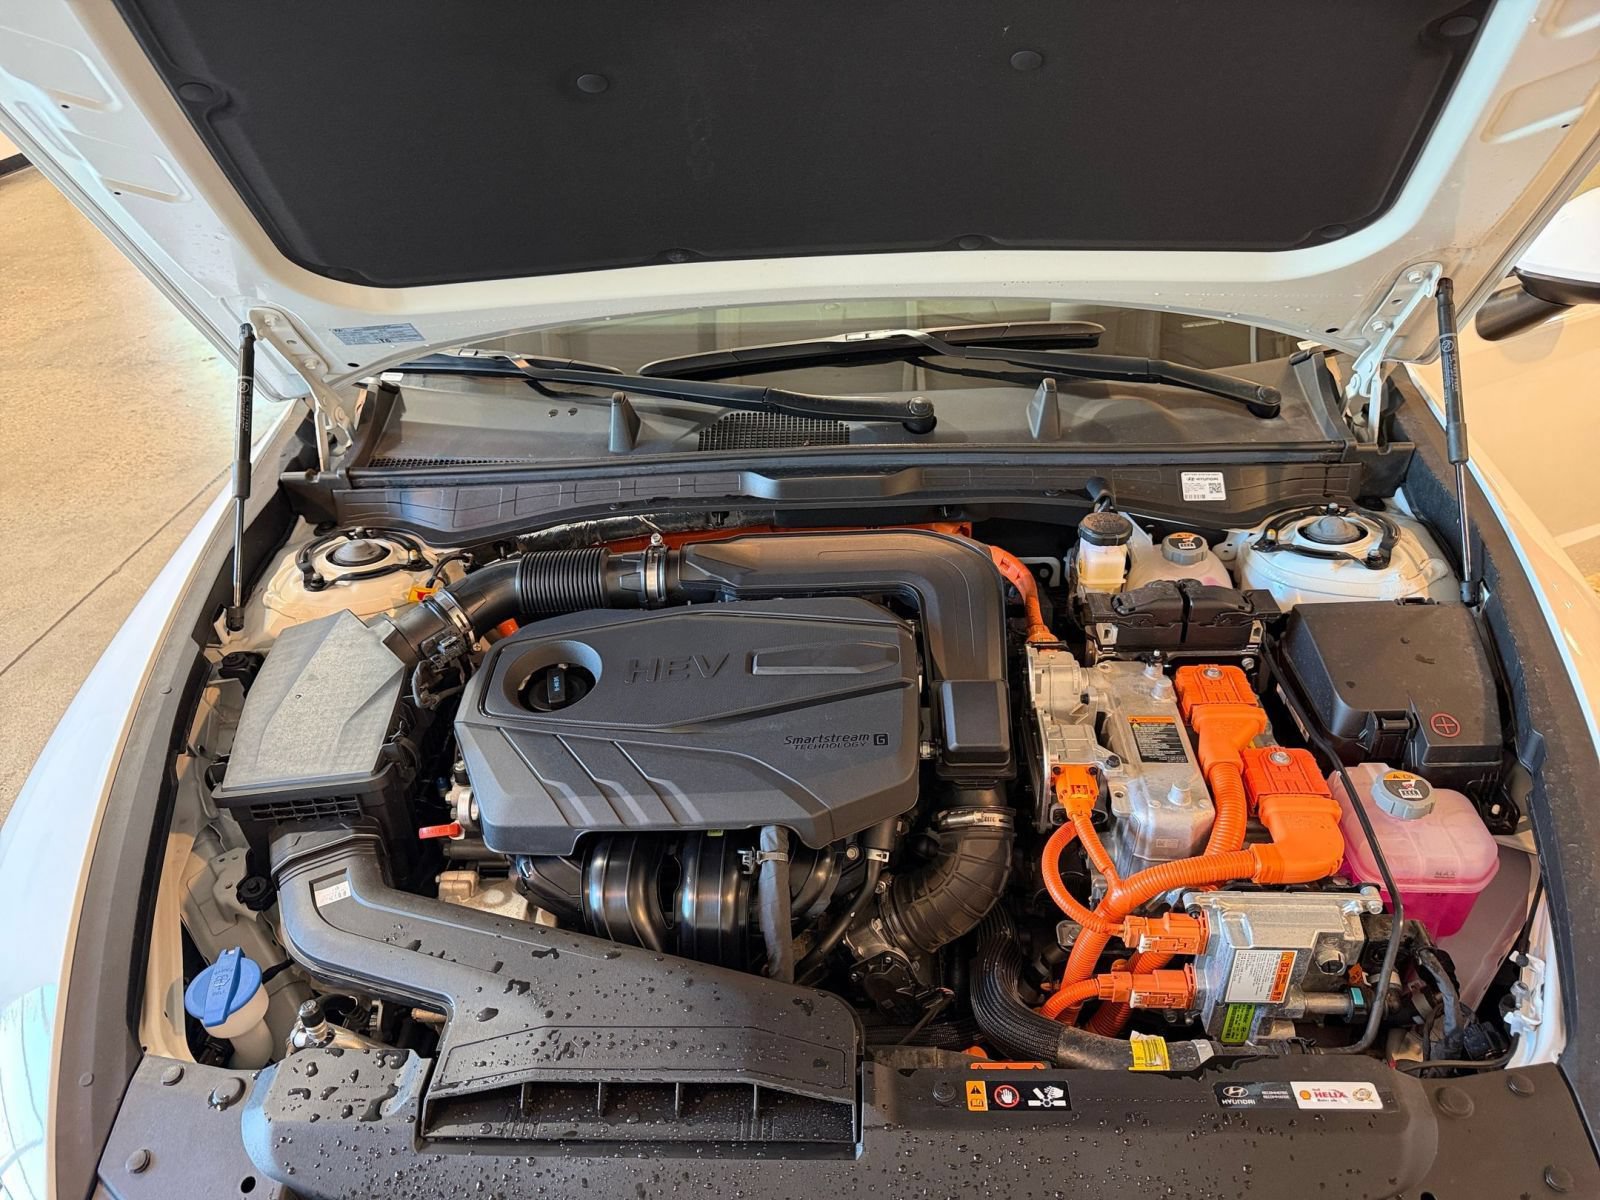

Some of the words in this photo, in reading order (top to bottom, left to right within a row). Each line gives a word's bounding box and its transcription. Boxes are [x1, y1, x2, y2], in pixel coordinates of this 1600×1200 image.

[624, 652, 730, 683] HEV
[783, 733, 871, 746] Smartstream
[793, 741, 867, 751] TECHNOLOGY
[1313, 1091, 1346, 1099] HELIX
